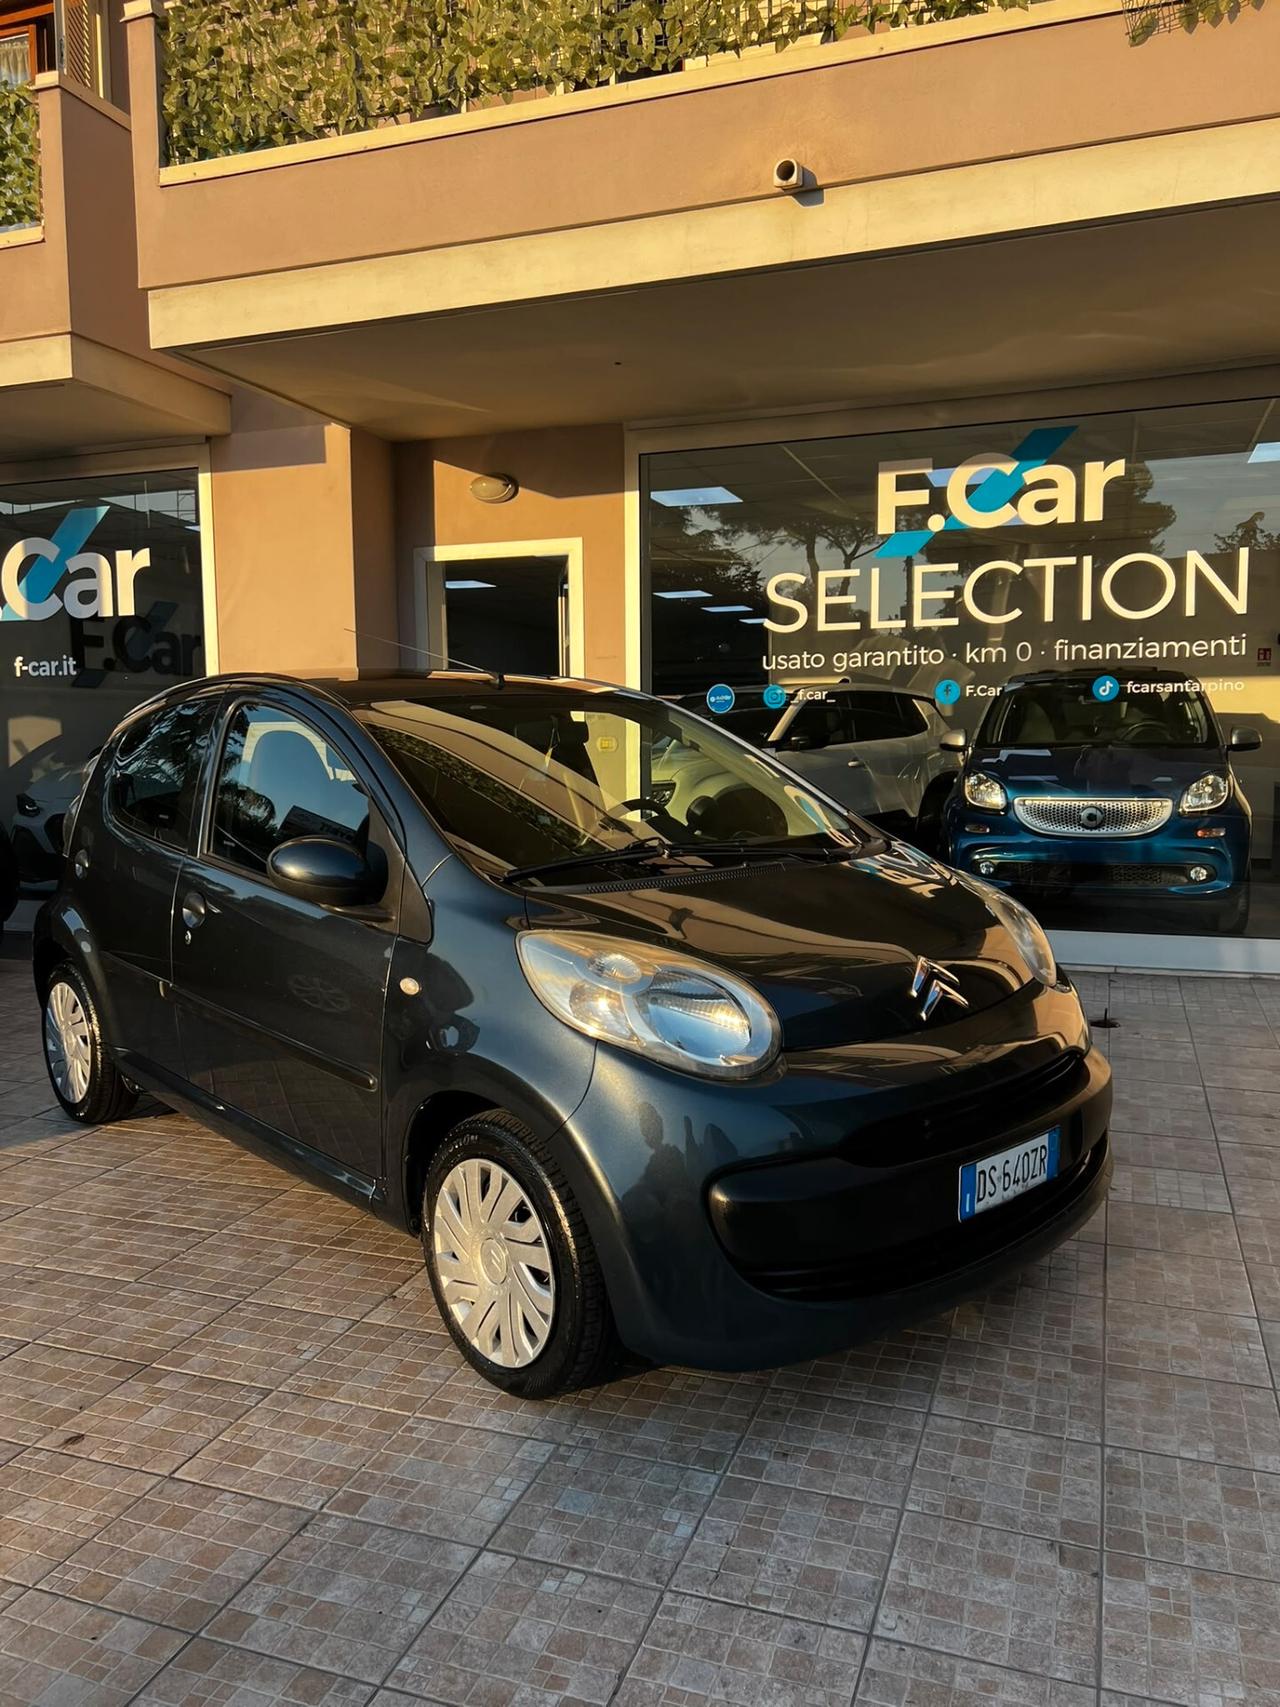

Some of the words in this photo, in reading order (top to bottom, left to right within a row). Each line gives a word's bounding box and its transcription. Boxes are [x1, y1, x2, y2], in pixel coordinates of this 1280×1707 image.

[877, 452, 1126, 535] F.Car
[0, 537, 150, 620] Car
[763, 547, 1249, 633] SELECTION
[14, 655, 77, 677] f-car.it
[762, 650, 825, 670] usato
[833, 645, 944, 673] garantito
[966, 642, 1007, 664] km
[1016, 642, 1032, 663] 0
[1054, 634, 1247, 662] finanziamenti
[966, 684, 1002, 697] F.Car
[977, 1165, 997, 1204] DS
